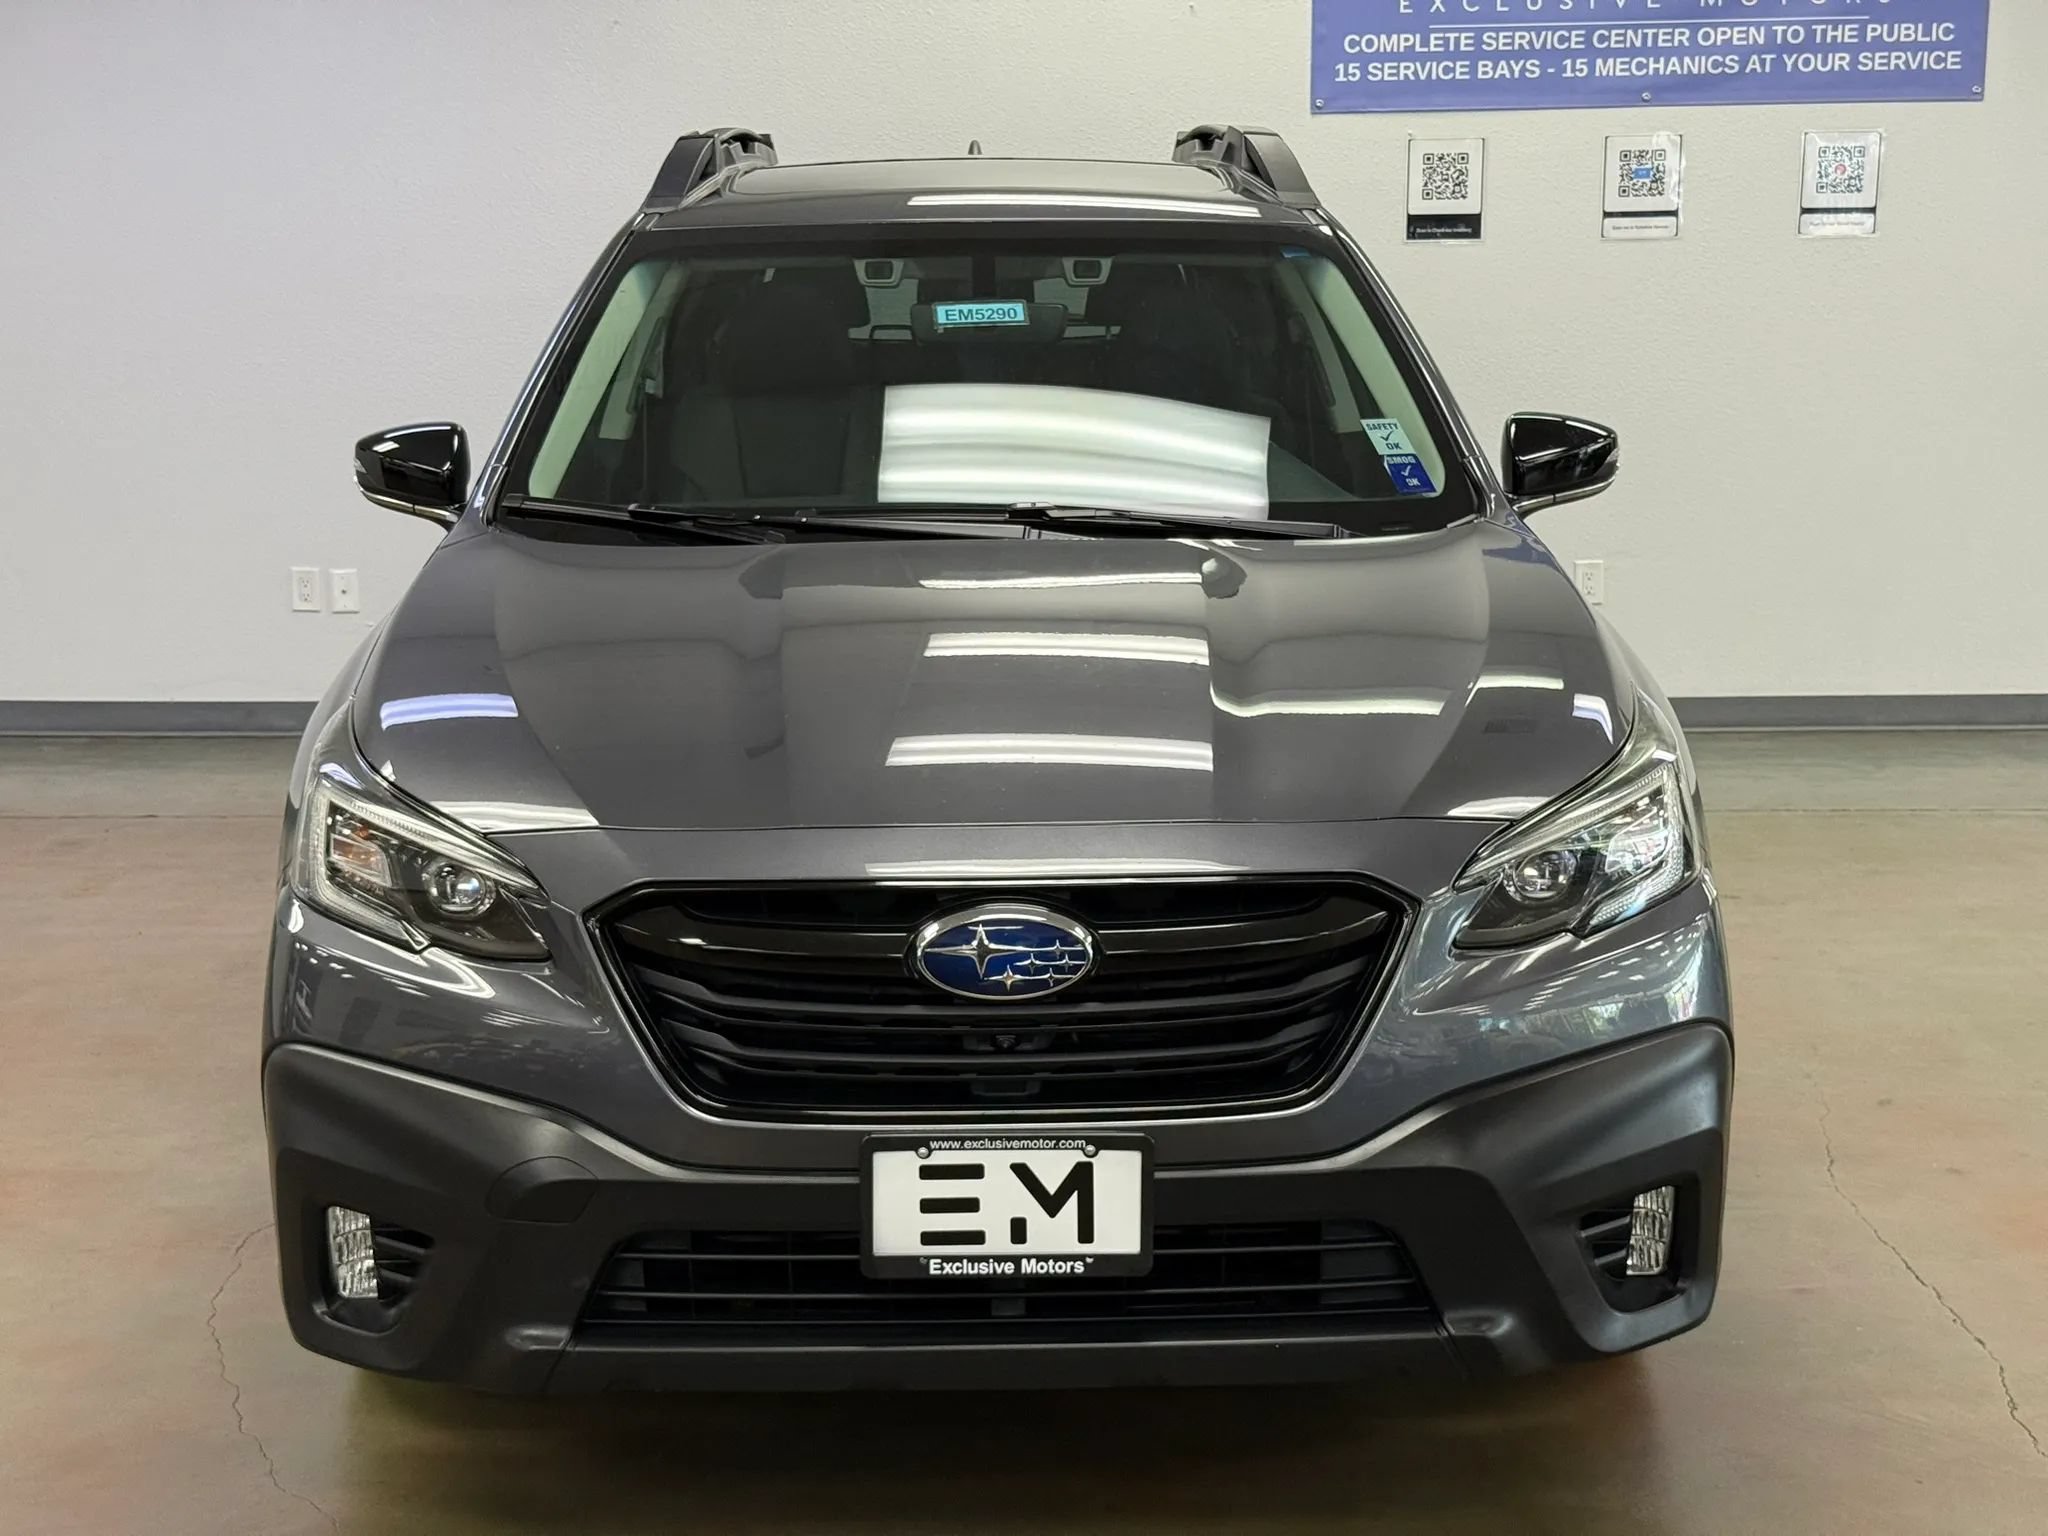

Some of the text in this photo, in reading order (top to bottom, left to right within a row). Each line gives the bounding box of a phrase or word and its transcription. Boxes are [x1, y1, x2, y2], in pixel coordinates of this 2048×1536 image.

[1343, 22, 1956, 54] COMPLETE SERVICE CENTER OPEN TO THE PUBLIC
[1334, 62, 1361, 82] 15
[1367, 61, 1471, 82] SERVICE
[1476, 59, 1541, 80] BAYS
[1561, 58, 1588, 78] 15
[1595, 55, 1740, 77] MECHANICS
[1745, 54, 1777, 74] AT
[1782, 52, 1851, 73] YOUR
[1857, 51, 1962, 71] SERVICE
[945, 307, 1017, 321] EM5290
[1366, 423, 1399, 431] SAFETY
[1386, 456, 1416, 464] SMOG
[1406, 478, 1421, 486] OK
[929, 1138, 1086, 1149] www.exclusivemotor.com
[929, 1257, 1085, 1275] Exclusive Motors
